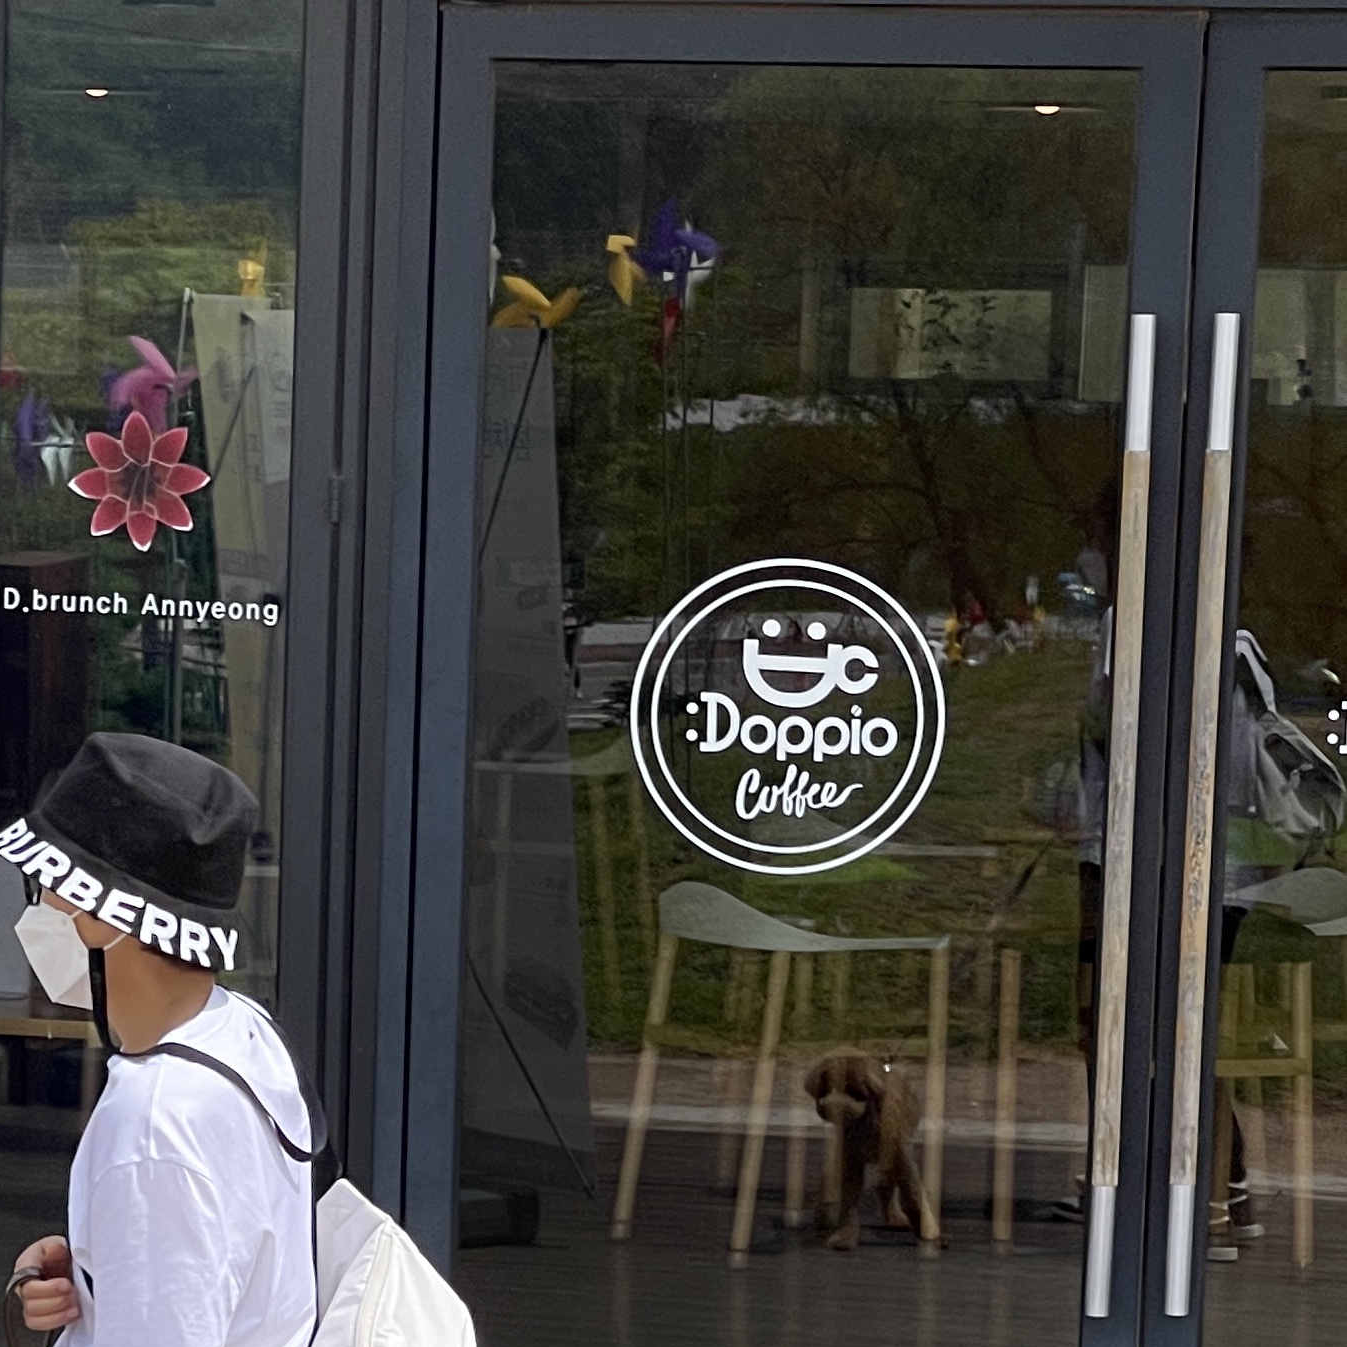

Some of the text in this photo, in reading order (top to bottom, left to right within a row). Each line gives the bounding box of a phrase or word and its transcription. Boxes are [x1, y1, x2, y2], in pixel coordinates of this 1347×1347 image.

[3, 586, 280, 626] D.brunch Annyeong
[735, 764, 863, 820] Coffee
